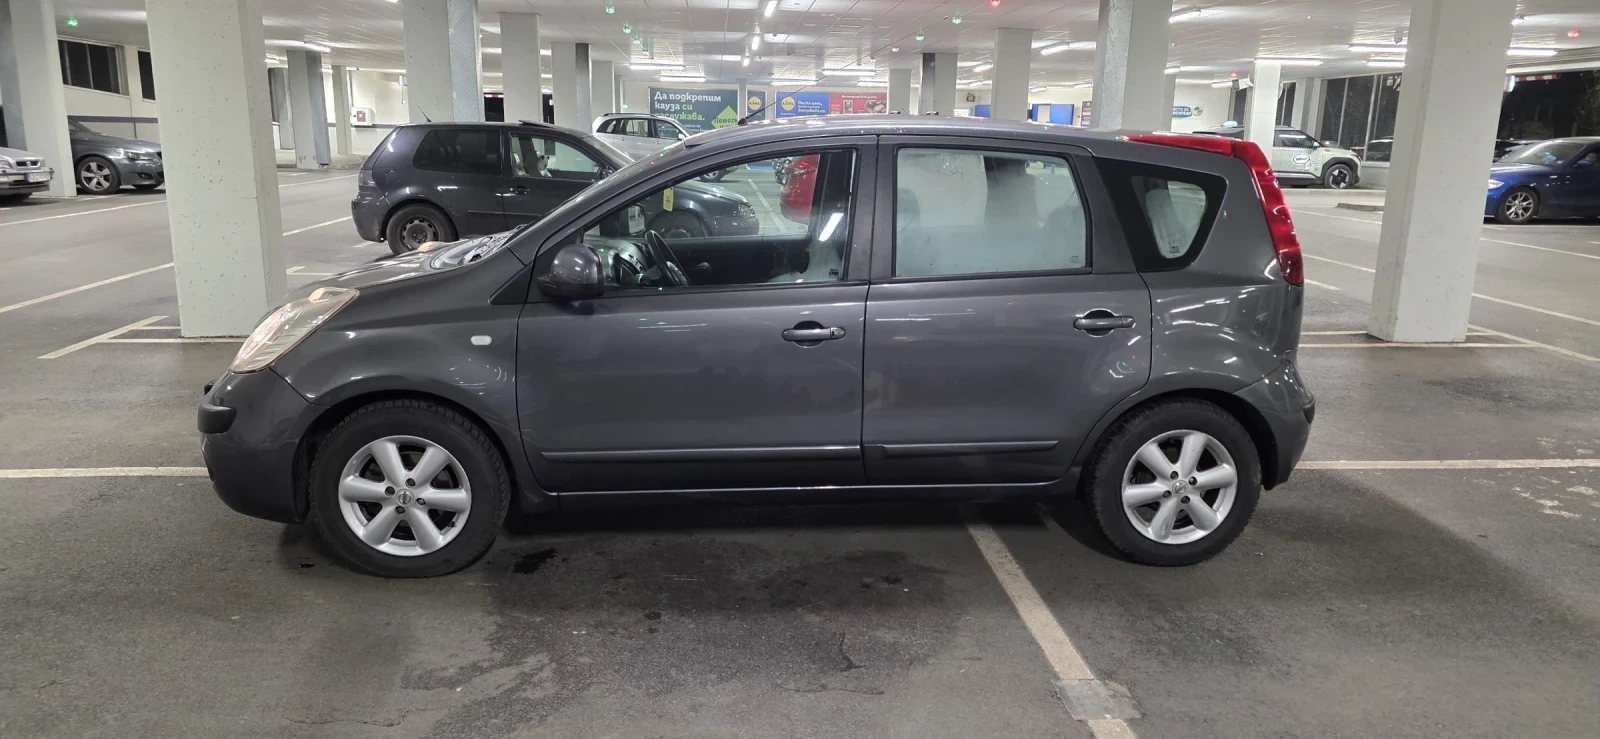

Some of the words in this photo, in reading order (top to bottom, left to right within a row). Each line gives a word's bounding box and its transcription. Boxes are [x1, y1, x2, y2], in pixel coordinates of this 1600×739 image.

[655, 92, 667, 100] Да
[670, 92, 722, 102] подкрепим
[655, 102, 680, 112] кауза
